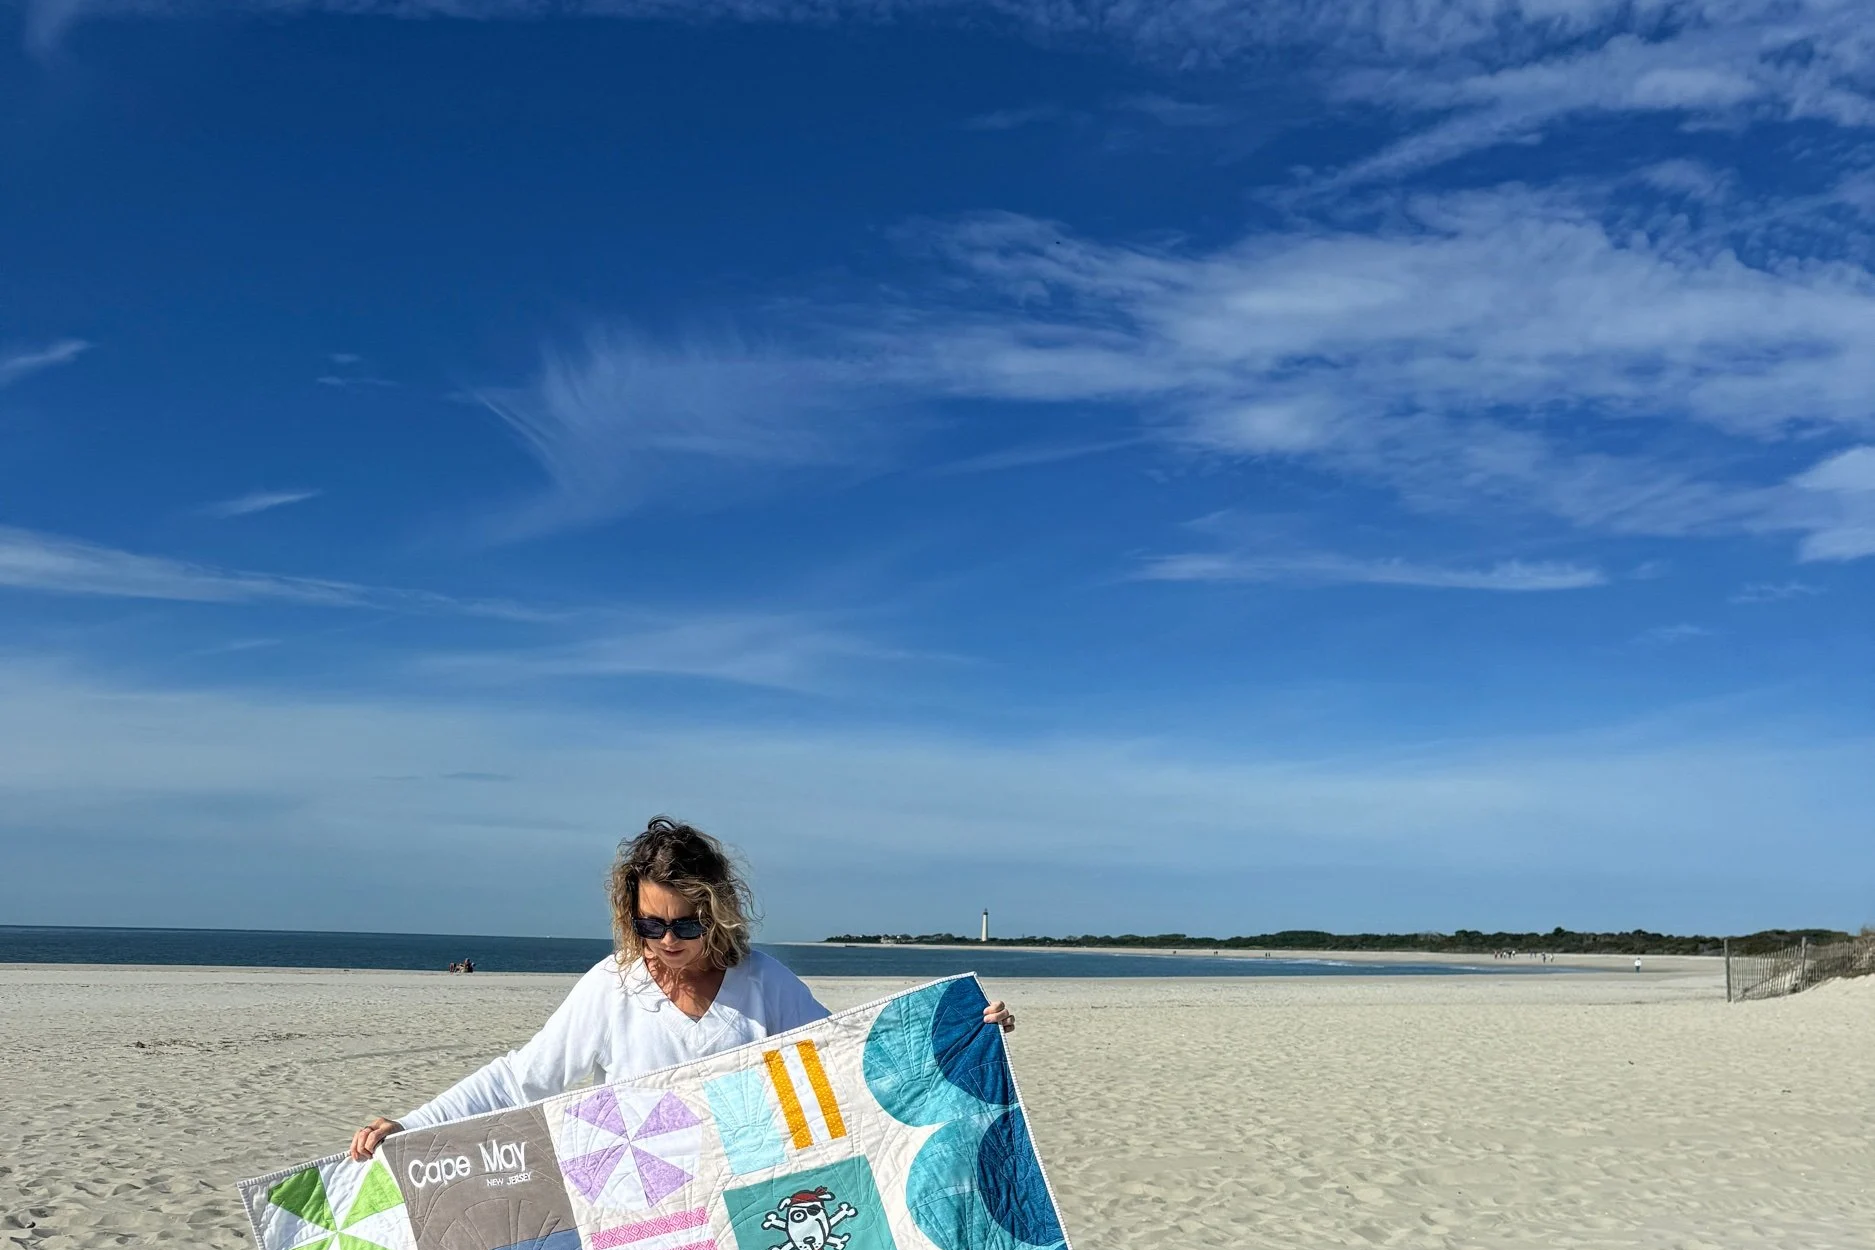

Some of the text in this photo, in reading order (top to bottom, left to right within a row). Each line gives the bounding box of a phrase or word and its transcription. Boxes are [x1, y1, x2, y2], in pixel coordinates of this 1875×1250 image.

[408, 1139, 528, 1188] Cape May
[486, 1172, 532, 1187] NEW JERSEY
